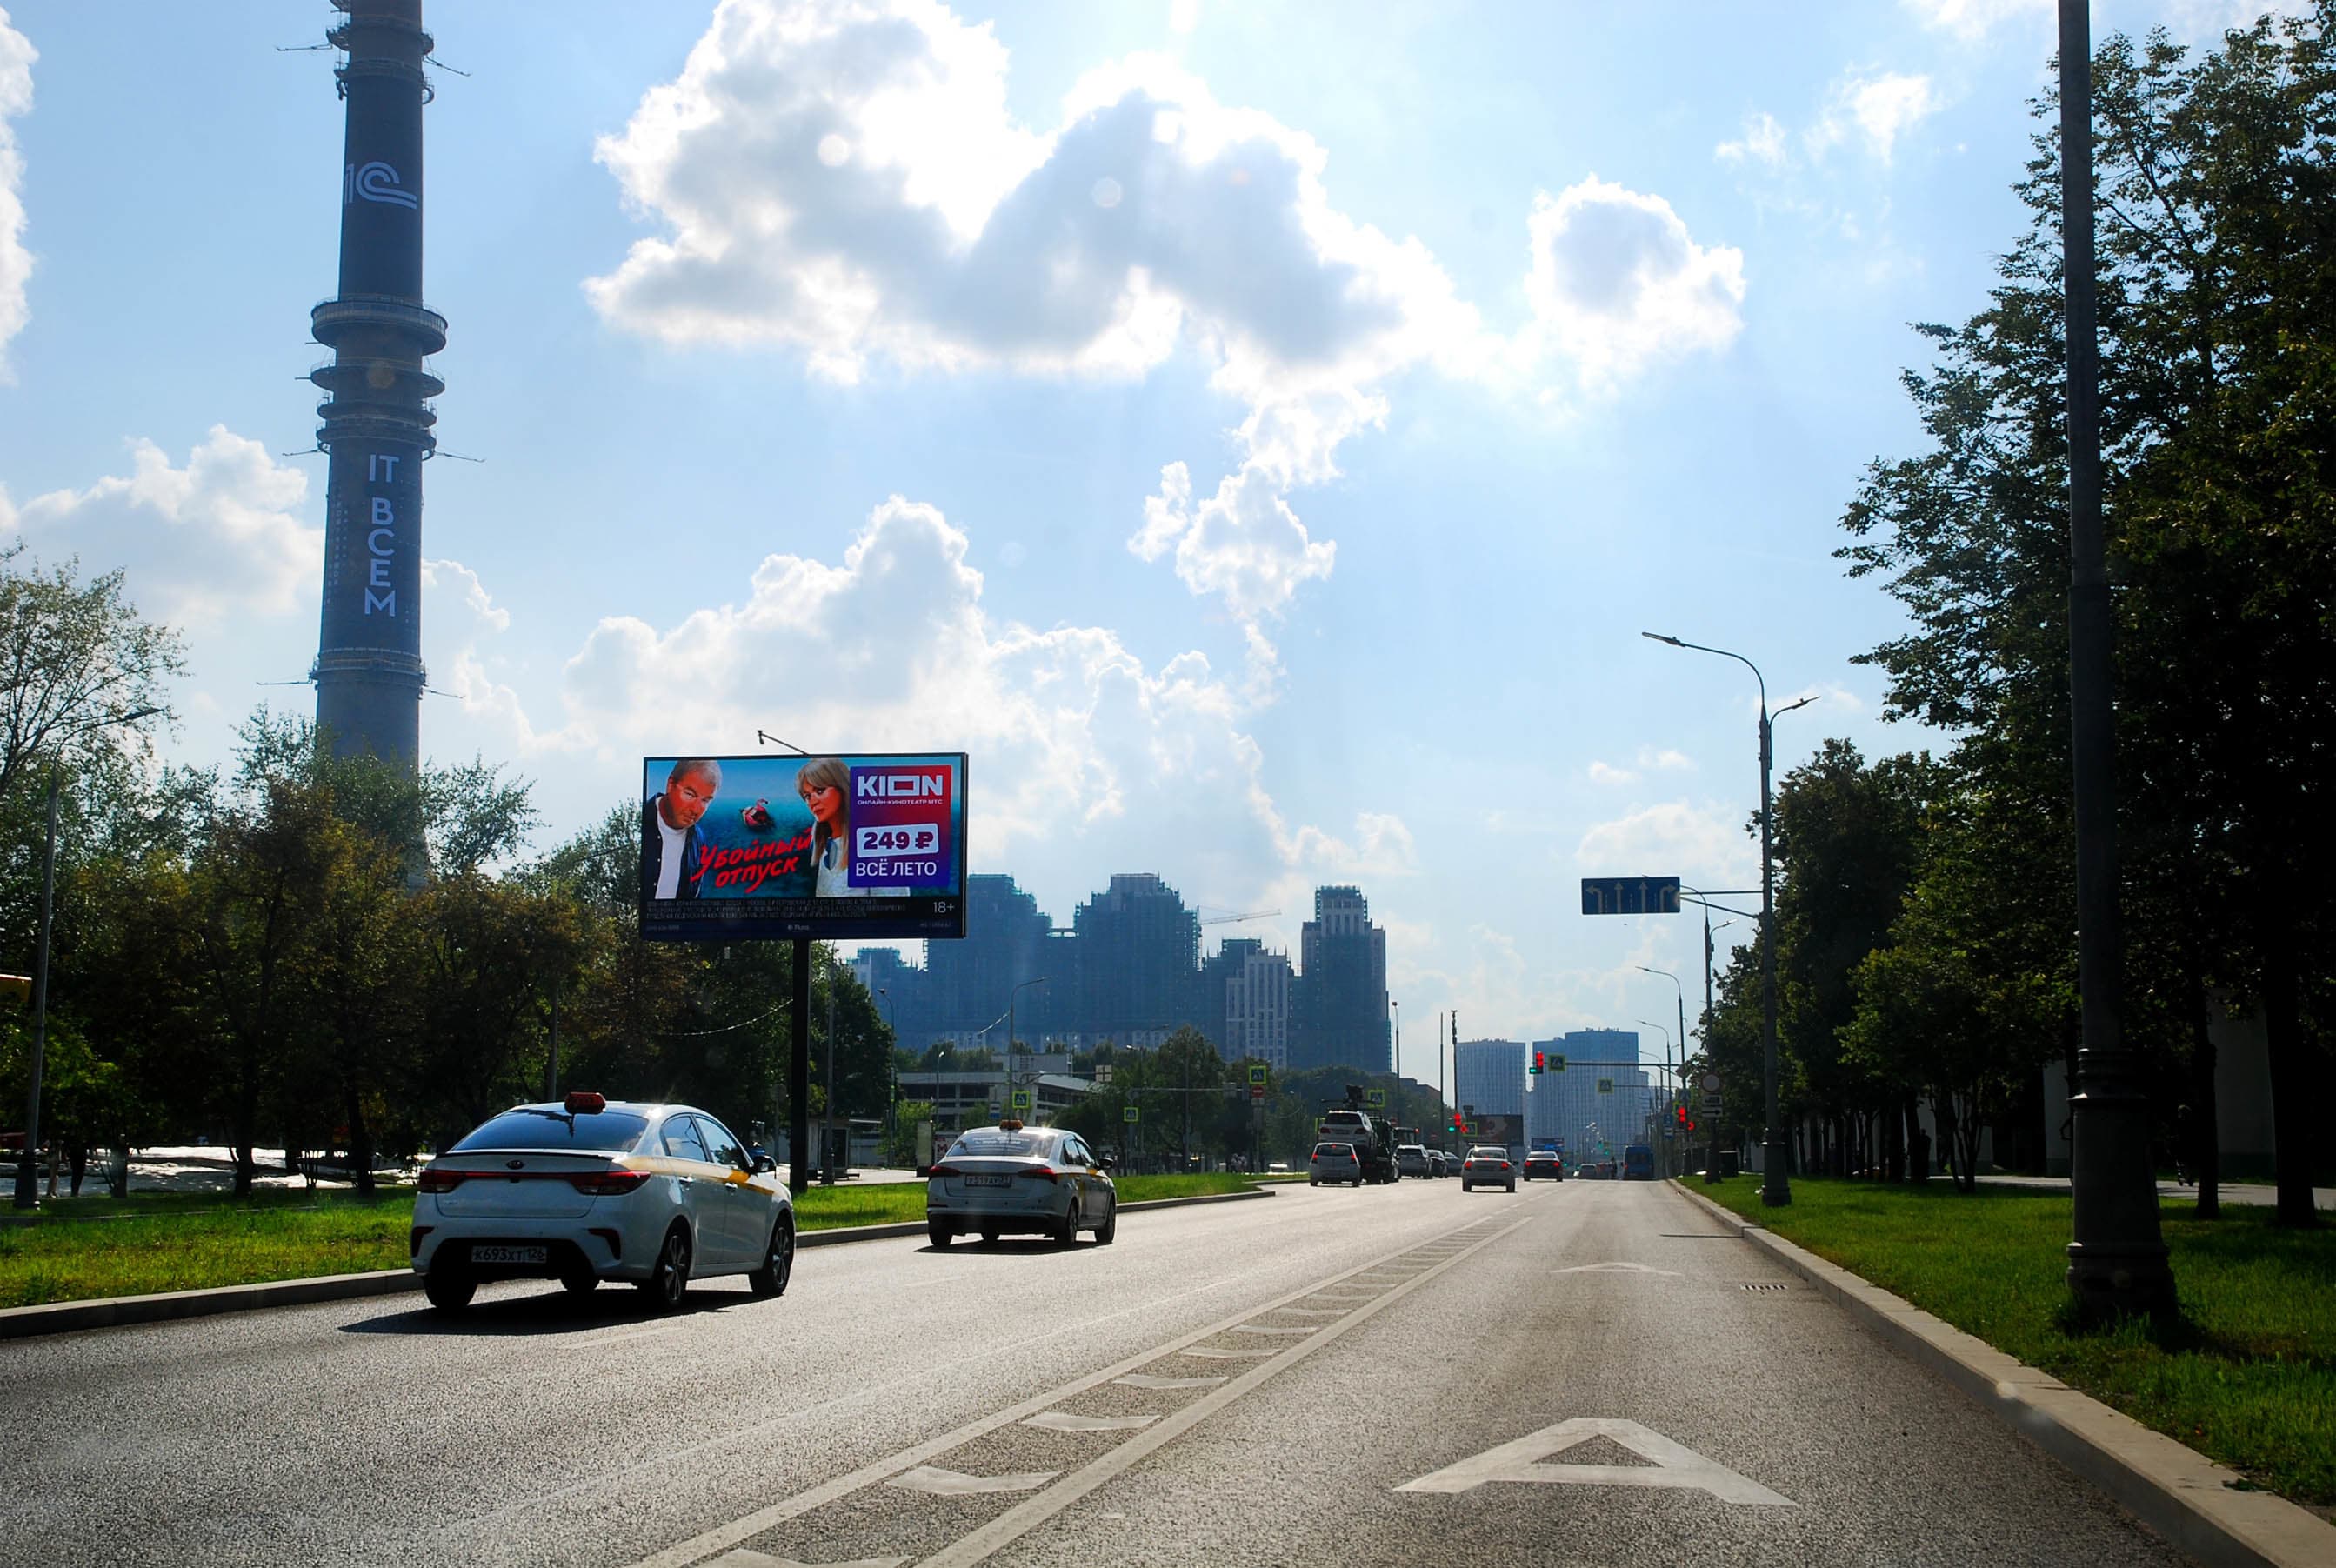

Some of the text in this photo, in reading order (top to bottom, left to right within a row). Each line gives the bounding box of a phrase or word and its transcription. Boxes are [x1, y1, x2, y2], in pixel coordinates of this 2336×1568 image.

[364, 497, 397, 617] ВСЕМ
[858, 775, 943, 797] KION
[864, 831, 934, 850] 249 ₽
[856, 858, 937, 877] ВСЁ ЛЕТО
[933, 901, 955, 913] 18+
